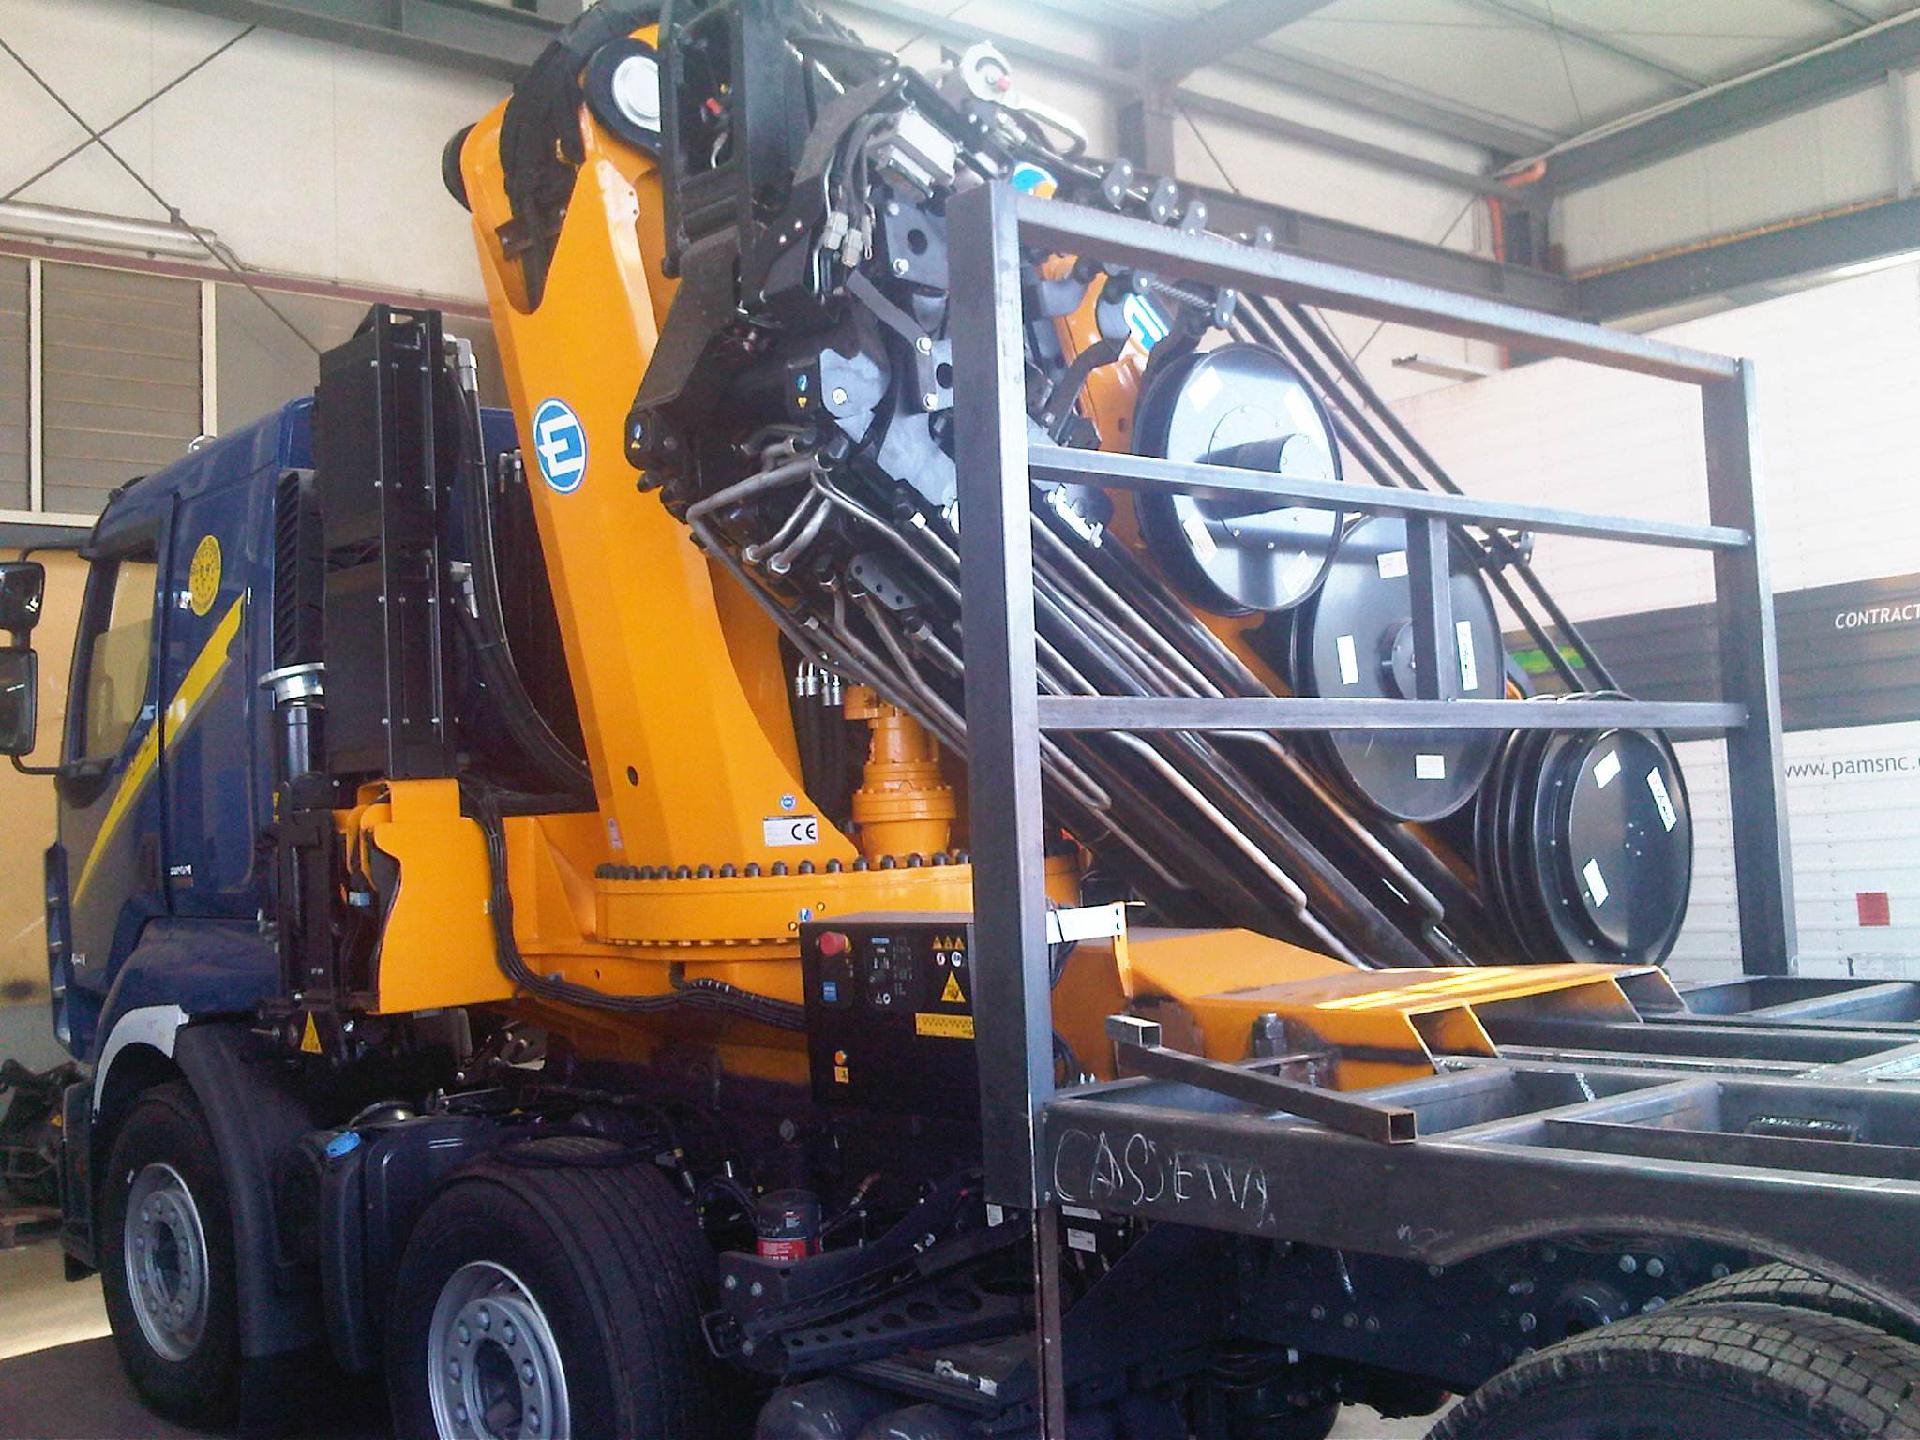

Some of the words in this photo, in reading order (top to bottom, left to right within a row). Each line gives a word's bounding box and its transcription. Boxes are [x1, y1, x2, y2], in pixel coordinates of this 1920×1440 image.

[1835, 603, 1920, 629] CONTRACT
[1785, 756, 1920, 780] www.pamsnc.
[791, 822, 817, 841] CE
